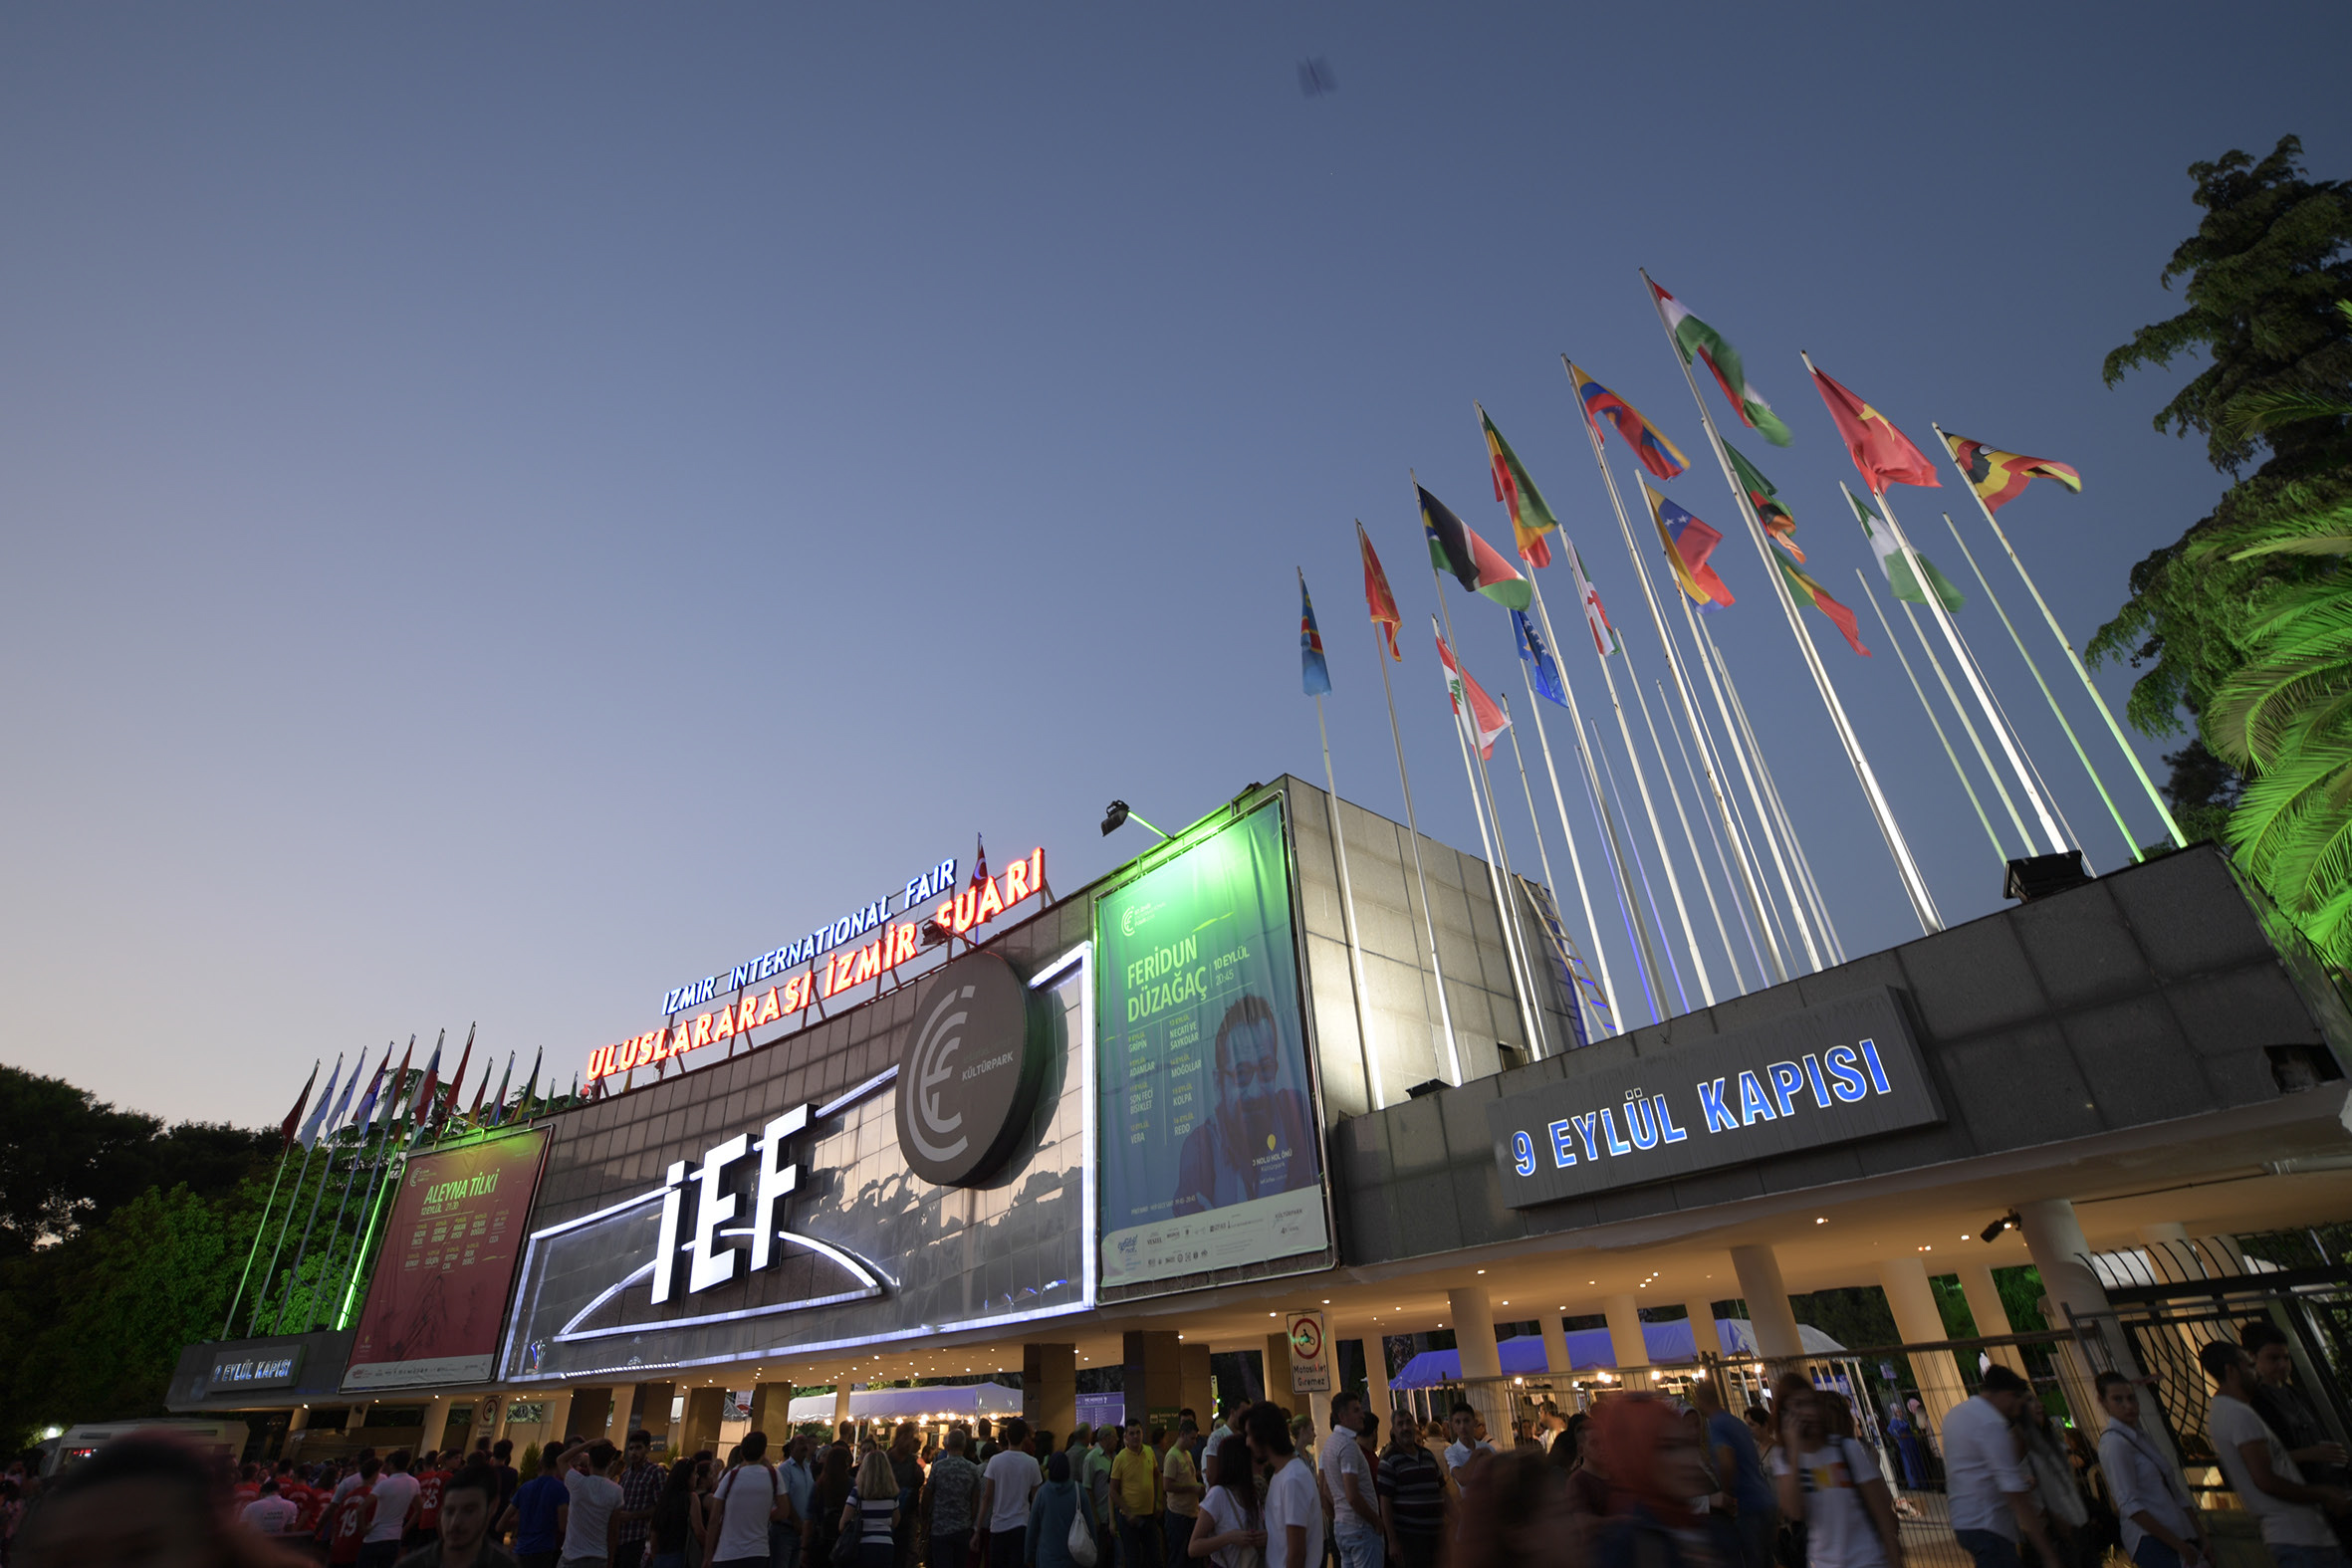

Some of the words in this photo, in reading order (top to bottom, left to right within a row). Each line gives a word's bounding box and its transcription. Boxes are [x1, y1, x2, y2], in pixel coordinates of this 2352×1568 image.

[661, 976, 717, 1015] IZMIR
[728, 895, 892, 993] INTERNATIONAL
[903, 858, 958, 909] FAIR
[587, 971, 814, 1081] ULUSLARARASI
[823, 922, 917, 999] İZMİR
[937, 846, 1046, 937] FUARI
[1127, 934, 1198, 990] FERİDUN
[1213, 958, 1223, 972] 10
[1223, 945, 1251, 969] EYLÜL
[1215, 969, 1235, 986] 20:45
[1127, 966, 1208, 1023] DÜZAĞAÇ
[1169, 1021, 1190, 1039] NECATİ
[1170, 1031, 1199, 1051] SAYKOLAR
[961, 1050, 1014, 1082] KÜLTÜRPARK
[1171, 1058, 1202, 1078] MOĞOLLAR
[1173, 1092, 1193, 1107] KOLPA
[1511, 1130, 1536, 1178] 9
[1547, 1087, 1688, 1170] EYLÜL
[1697, 1037, 1892, 1134] KAPISI
[1130, 1132, 1145, 1144] VERA
[423, 1179, 469, 1205] ALEYNA
[469, 1168, 501, 1197] TİLKİ
[212, 1364, 223, 1384] 9
[222, 1359, 253, 1382] EYLÜL
[254, 1358, 293, 1380] KAPISI
